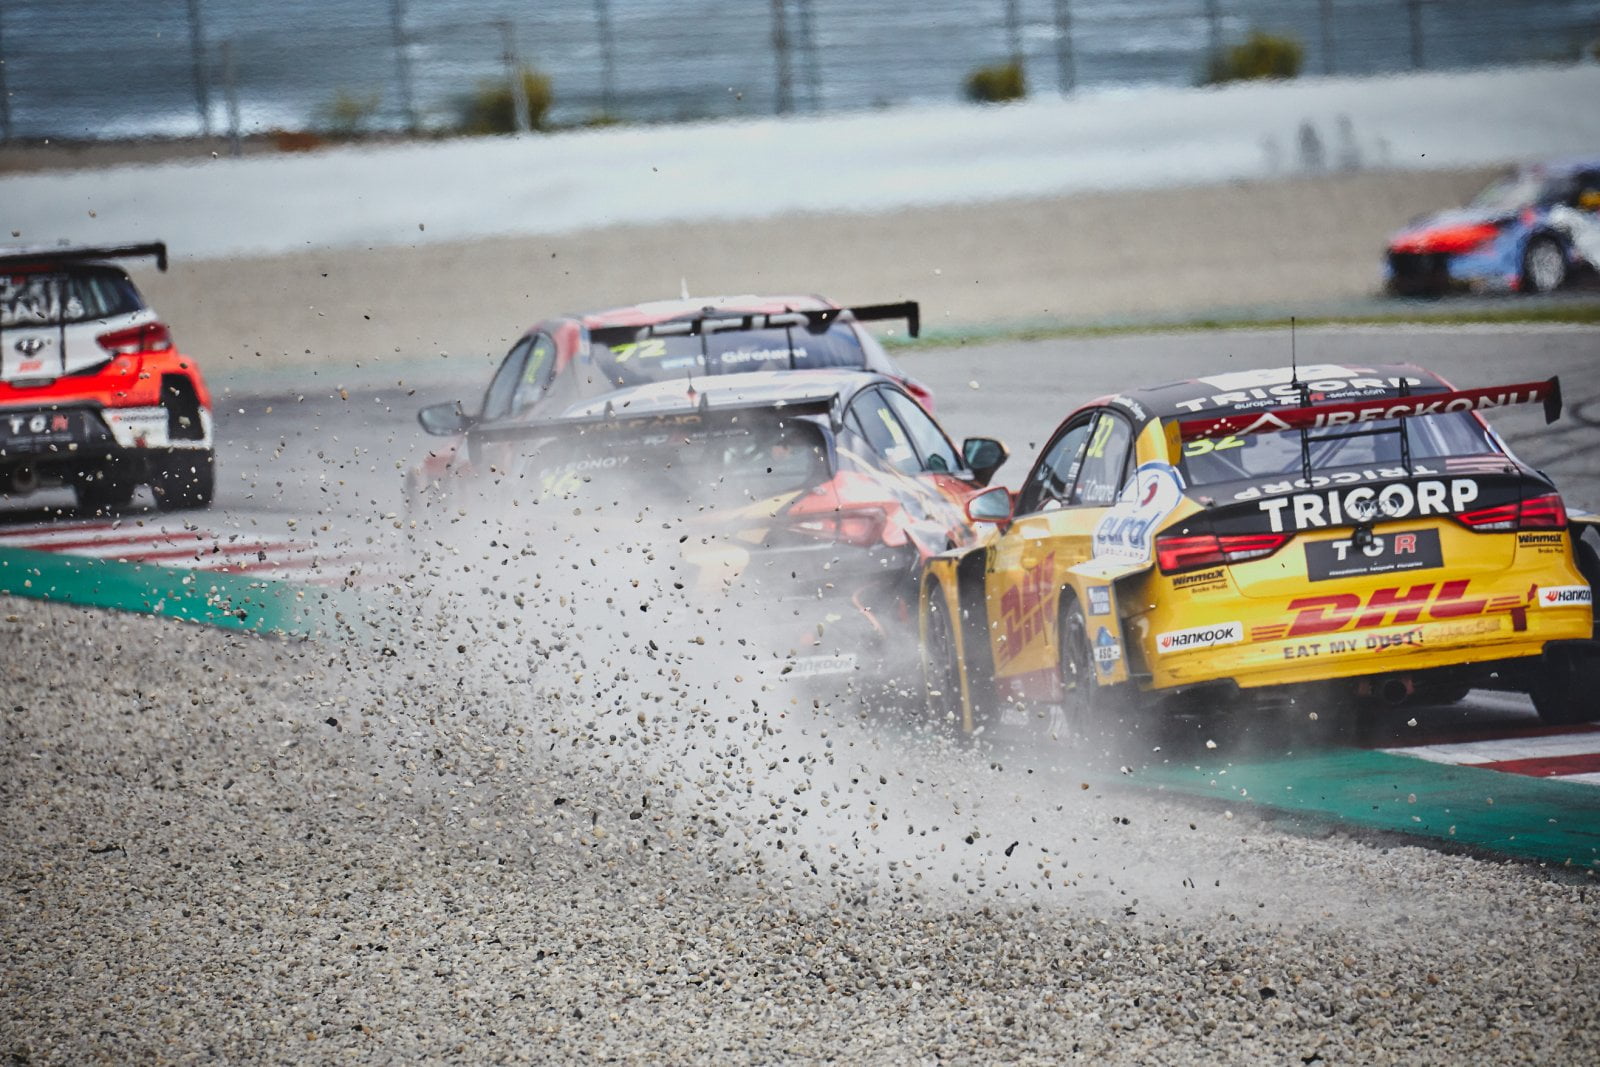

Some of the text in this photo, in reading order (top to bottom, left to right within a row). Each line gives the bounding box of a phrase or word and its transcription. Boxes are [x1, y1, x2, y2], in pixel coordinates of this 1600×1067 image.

[610, 339, 666, 363] 72
[1176, 376, 1421, 412] TRICORP
[1087, 414, 1115, 458] 32
[1184, 435, 1247, 458] 32
[1233, 463, 1439, 500] TRICORP
[1258, 478, 1479, 533] TRICORP
[1518, 533, 1562, 543] Winmax
[1172, 568, 1225, 587] Winmax
[1001, 551, 1057, 662] DHL
[1286, 579, 1488, 637] DHL
[1283, 644, 1321, 660] EAT
[1330, 637, 1358, 655] MY
